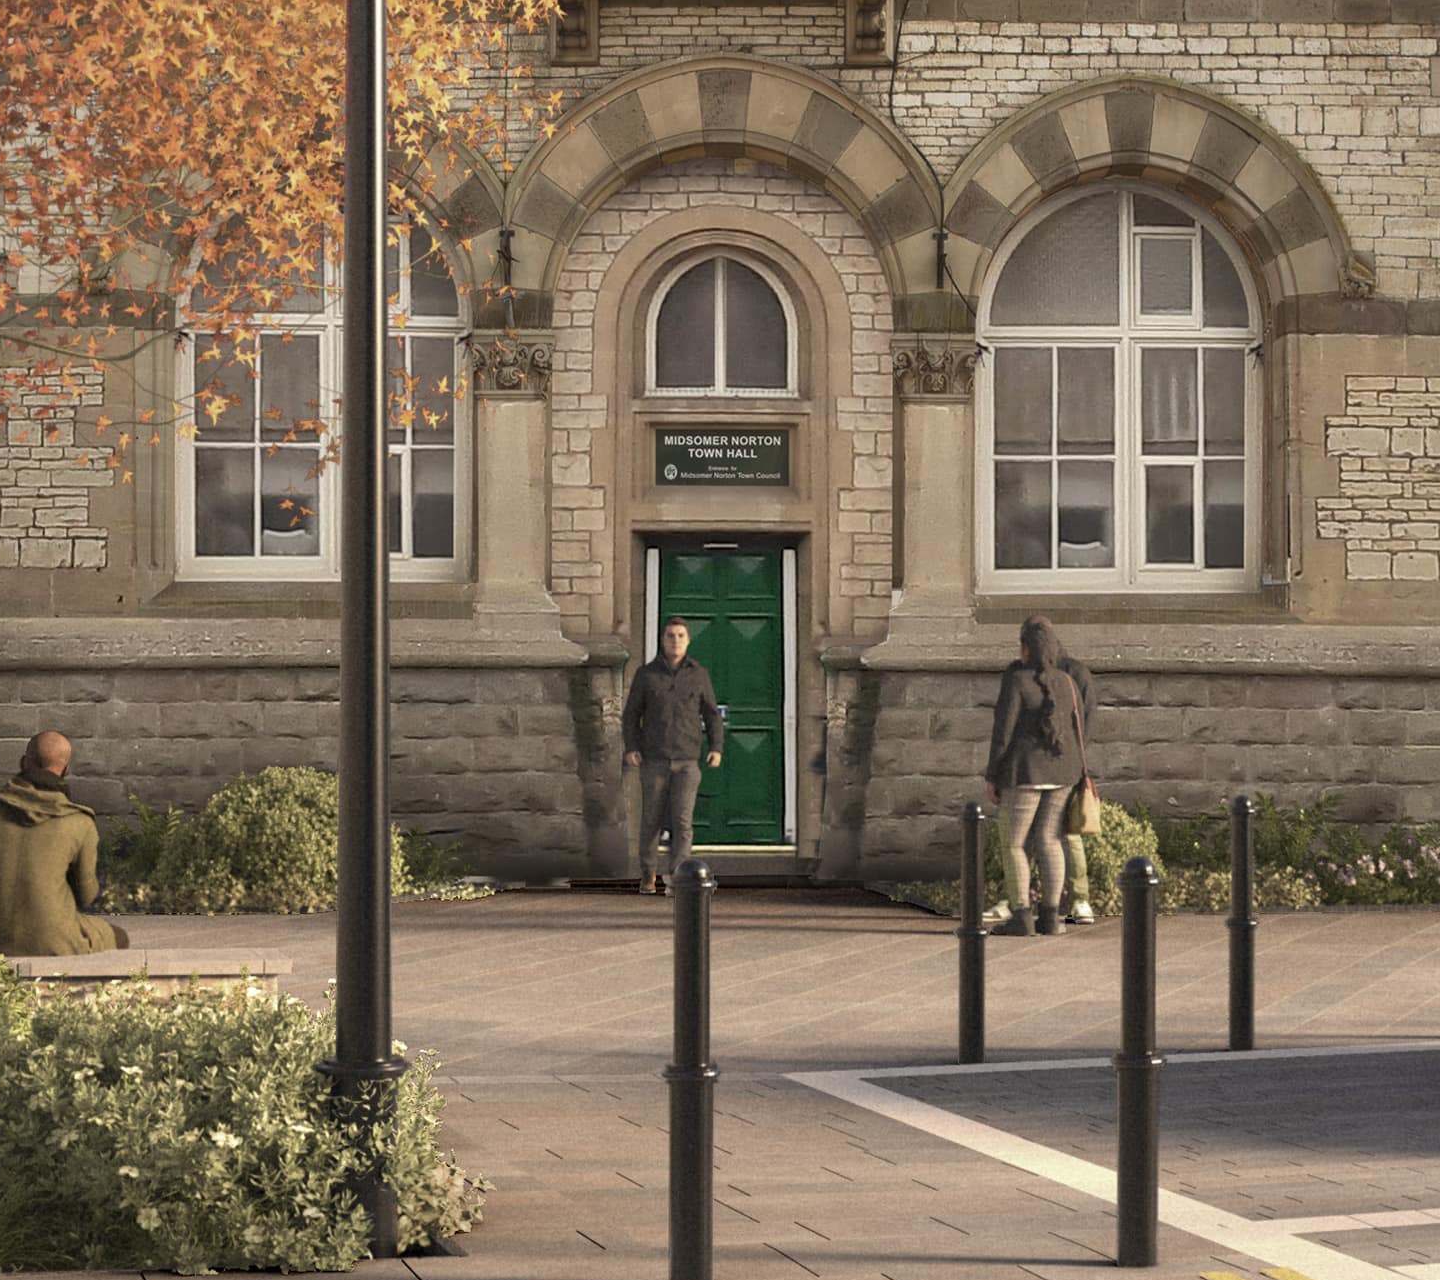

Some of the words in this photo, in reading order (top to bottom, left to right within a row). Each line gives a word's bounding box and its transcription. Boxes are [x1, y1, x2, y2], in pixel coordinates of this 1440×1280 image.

[664, 435, 729, 446] MIDSOMER
[731, 435, 782, 446] NORTON
[687, 448, 723, 458] TOWN
[726, 448, 758, 458] HALL
